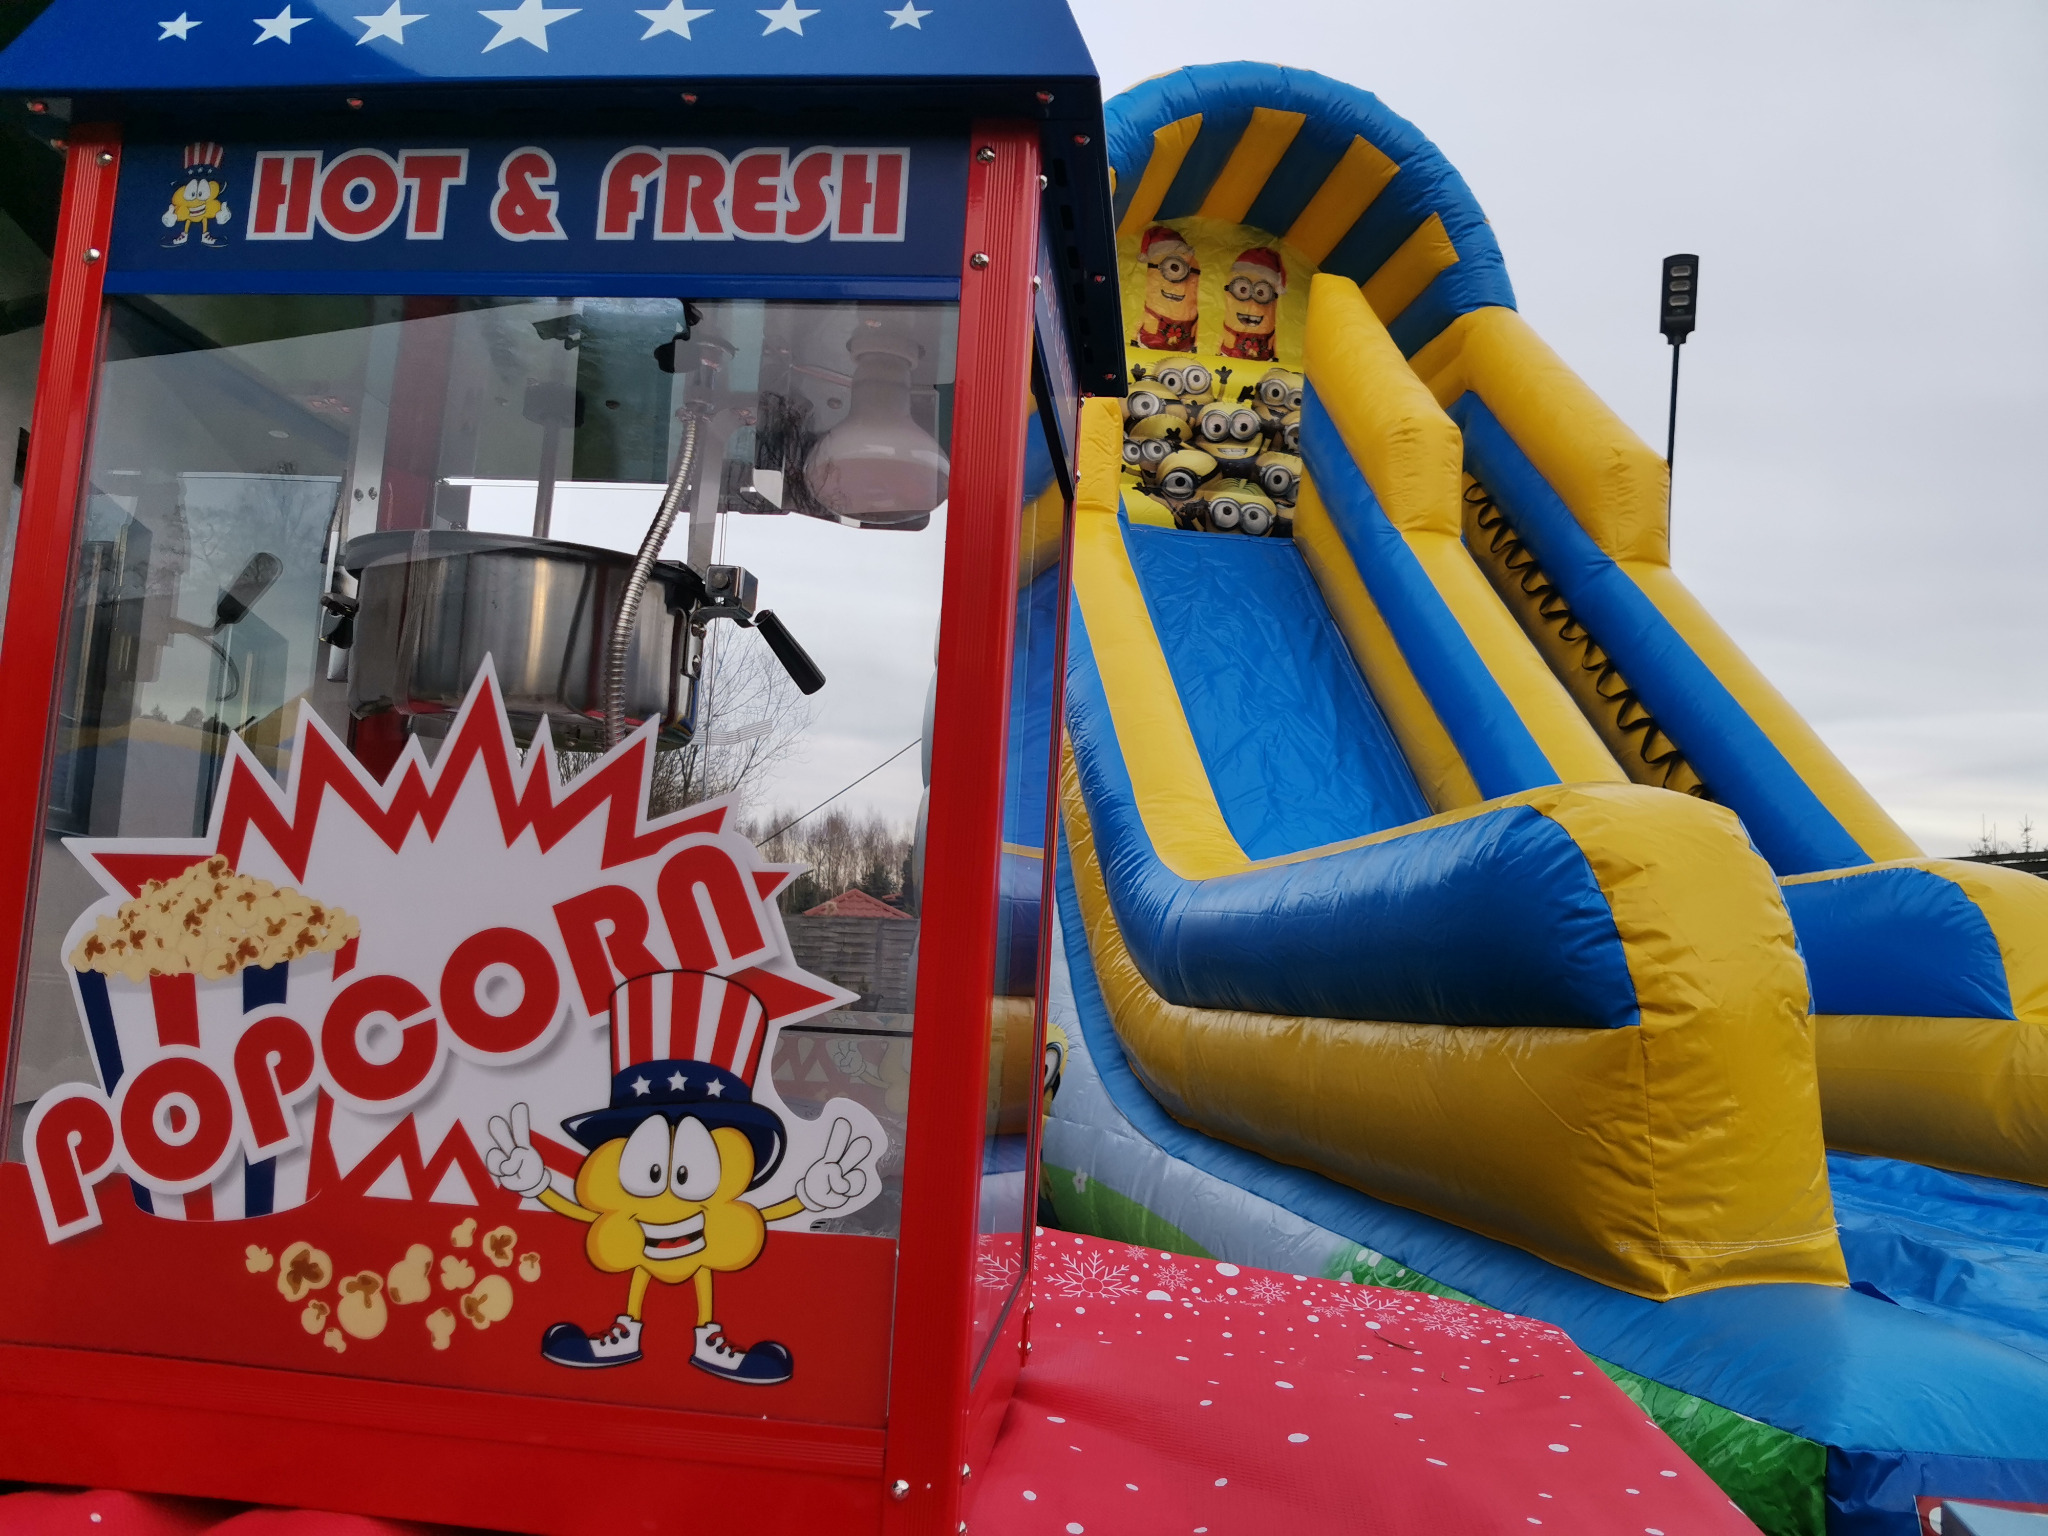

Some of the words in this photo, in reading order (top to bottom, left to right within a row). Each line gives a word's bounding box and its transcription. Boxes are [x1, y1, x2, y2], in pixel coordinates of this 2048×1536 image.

[247, 148, 470, 241] HOT
[489, 146, 568, 241] &
[595, 145, 911, 243] FRESH
[28, 840, 771, 1238] POPCORN
